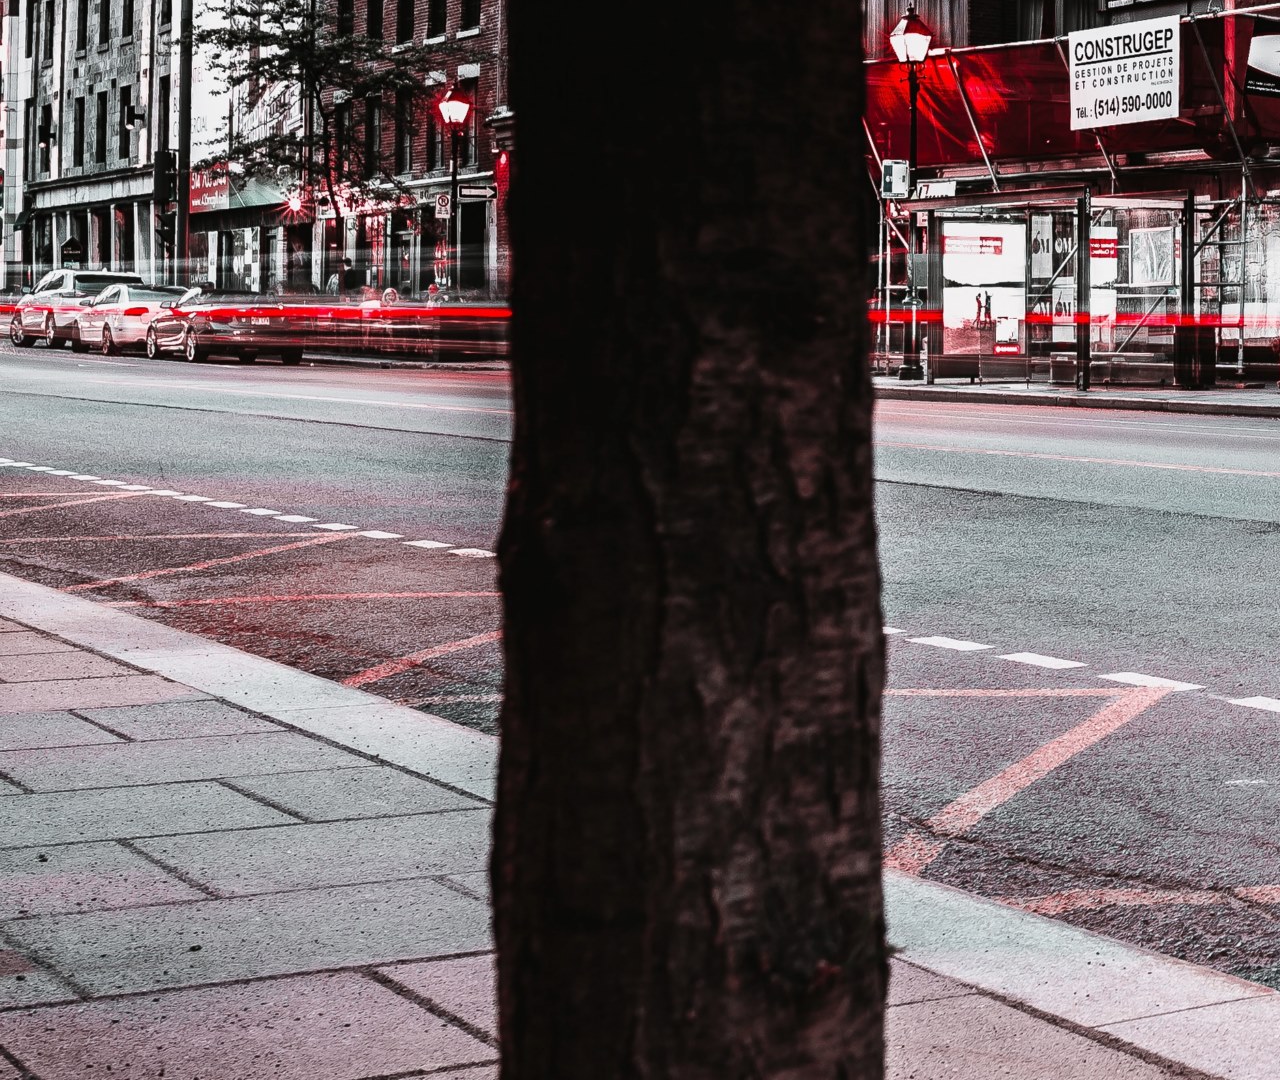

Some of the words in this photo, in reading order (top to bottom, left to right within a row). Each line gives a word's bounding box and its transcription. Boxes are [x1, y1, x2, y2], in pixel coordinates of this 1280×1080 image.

[1074, 28, 1174, 62] CONSTRUGEP
[1075, 65, 1112, 79] GESTION
[1117, 63, 1128, 73] DE
[1132, 56, 1174, 70] PROJETS
[1075, 80, 1086, 91] ET
[1092, 68, 1174, 88] CONSTRUCTION
[1094, 95, 1120, 120] (514)
[1121, 90, 1173, 114] 590-0000
